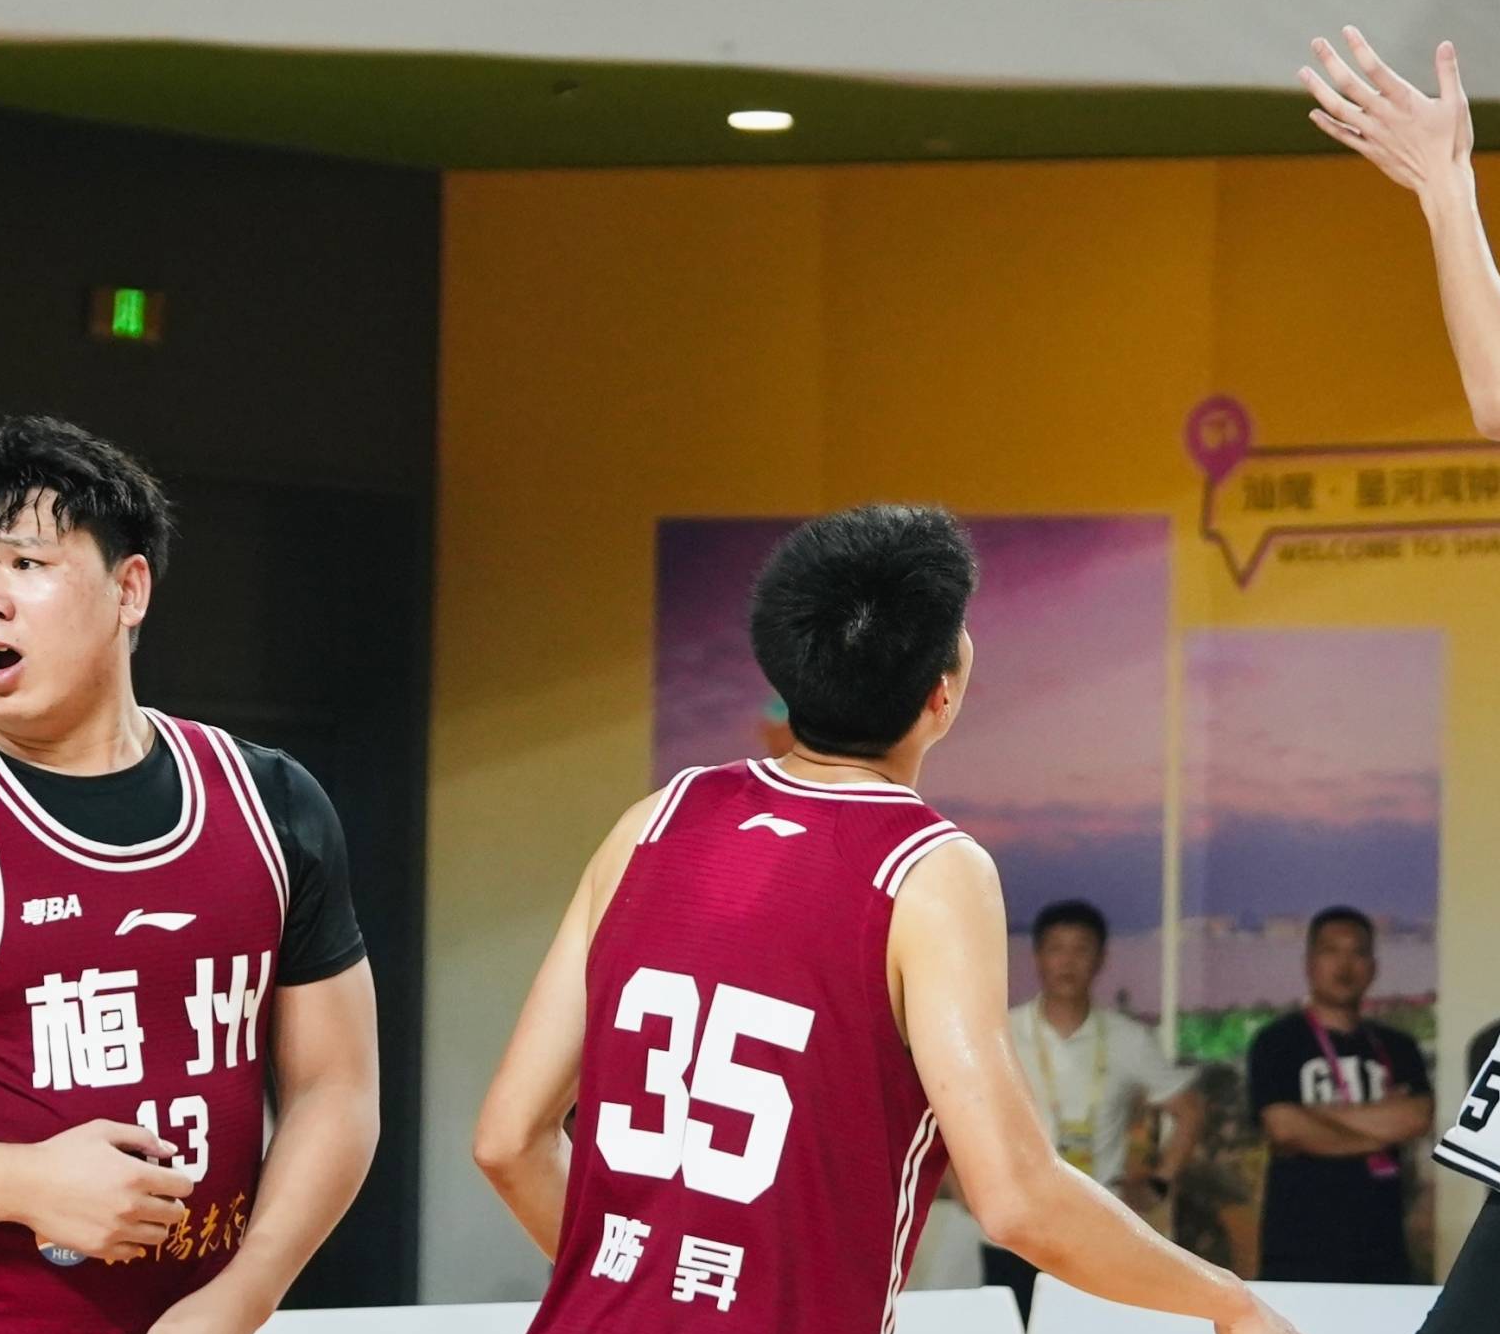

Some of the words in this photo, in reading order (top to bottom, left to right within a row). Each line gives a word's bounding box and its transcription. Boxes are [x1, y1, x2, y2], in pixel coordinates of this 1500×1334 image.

[20, 894, 82, 926] 粤BA
[25, 950, 272, 1091] 梅州
[595, 967, 816, 1204] 35
[135, 1095, 210, 1183] 13
[51, 1246, 79, 1262] HEC
[590, 1213, 745, 1312] 陈昇
